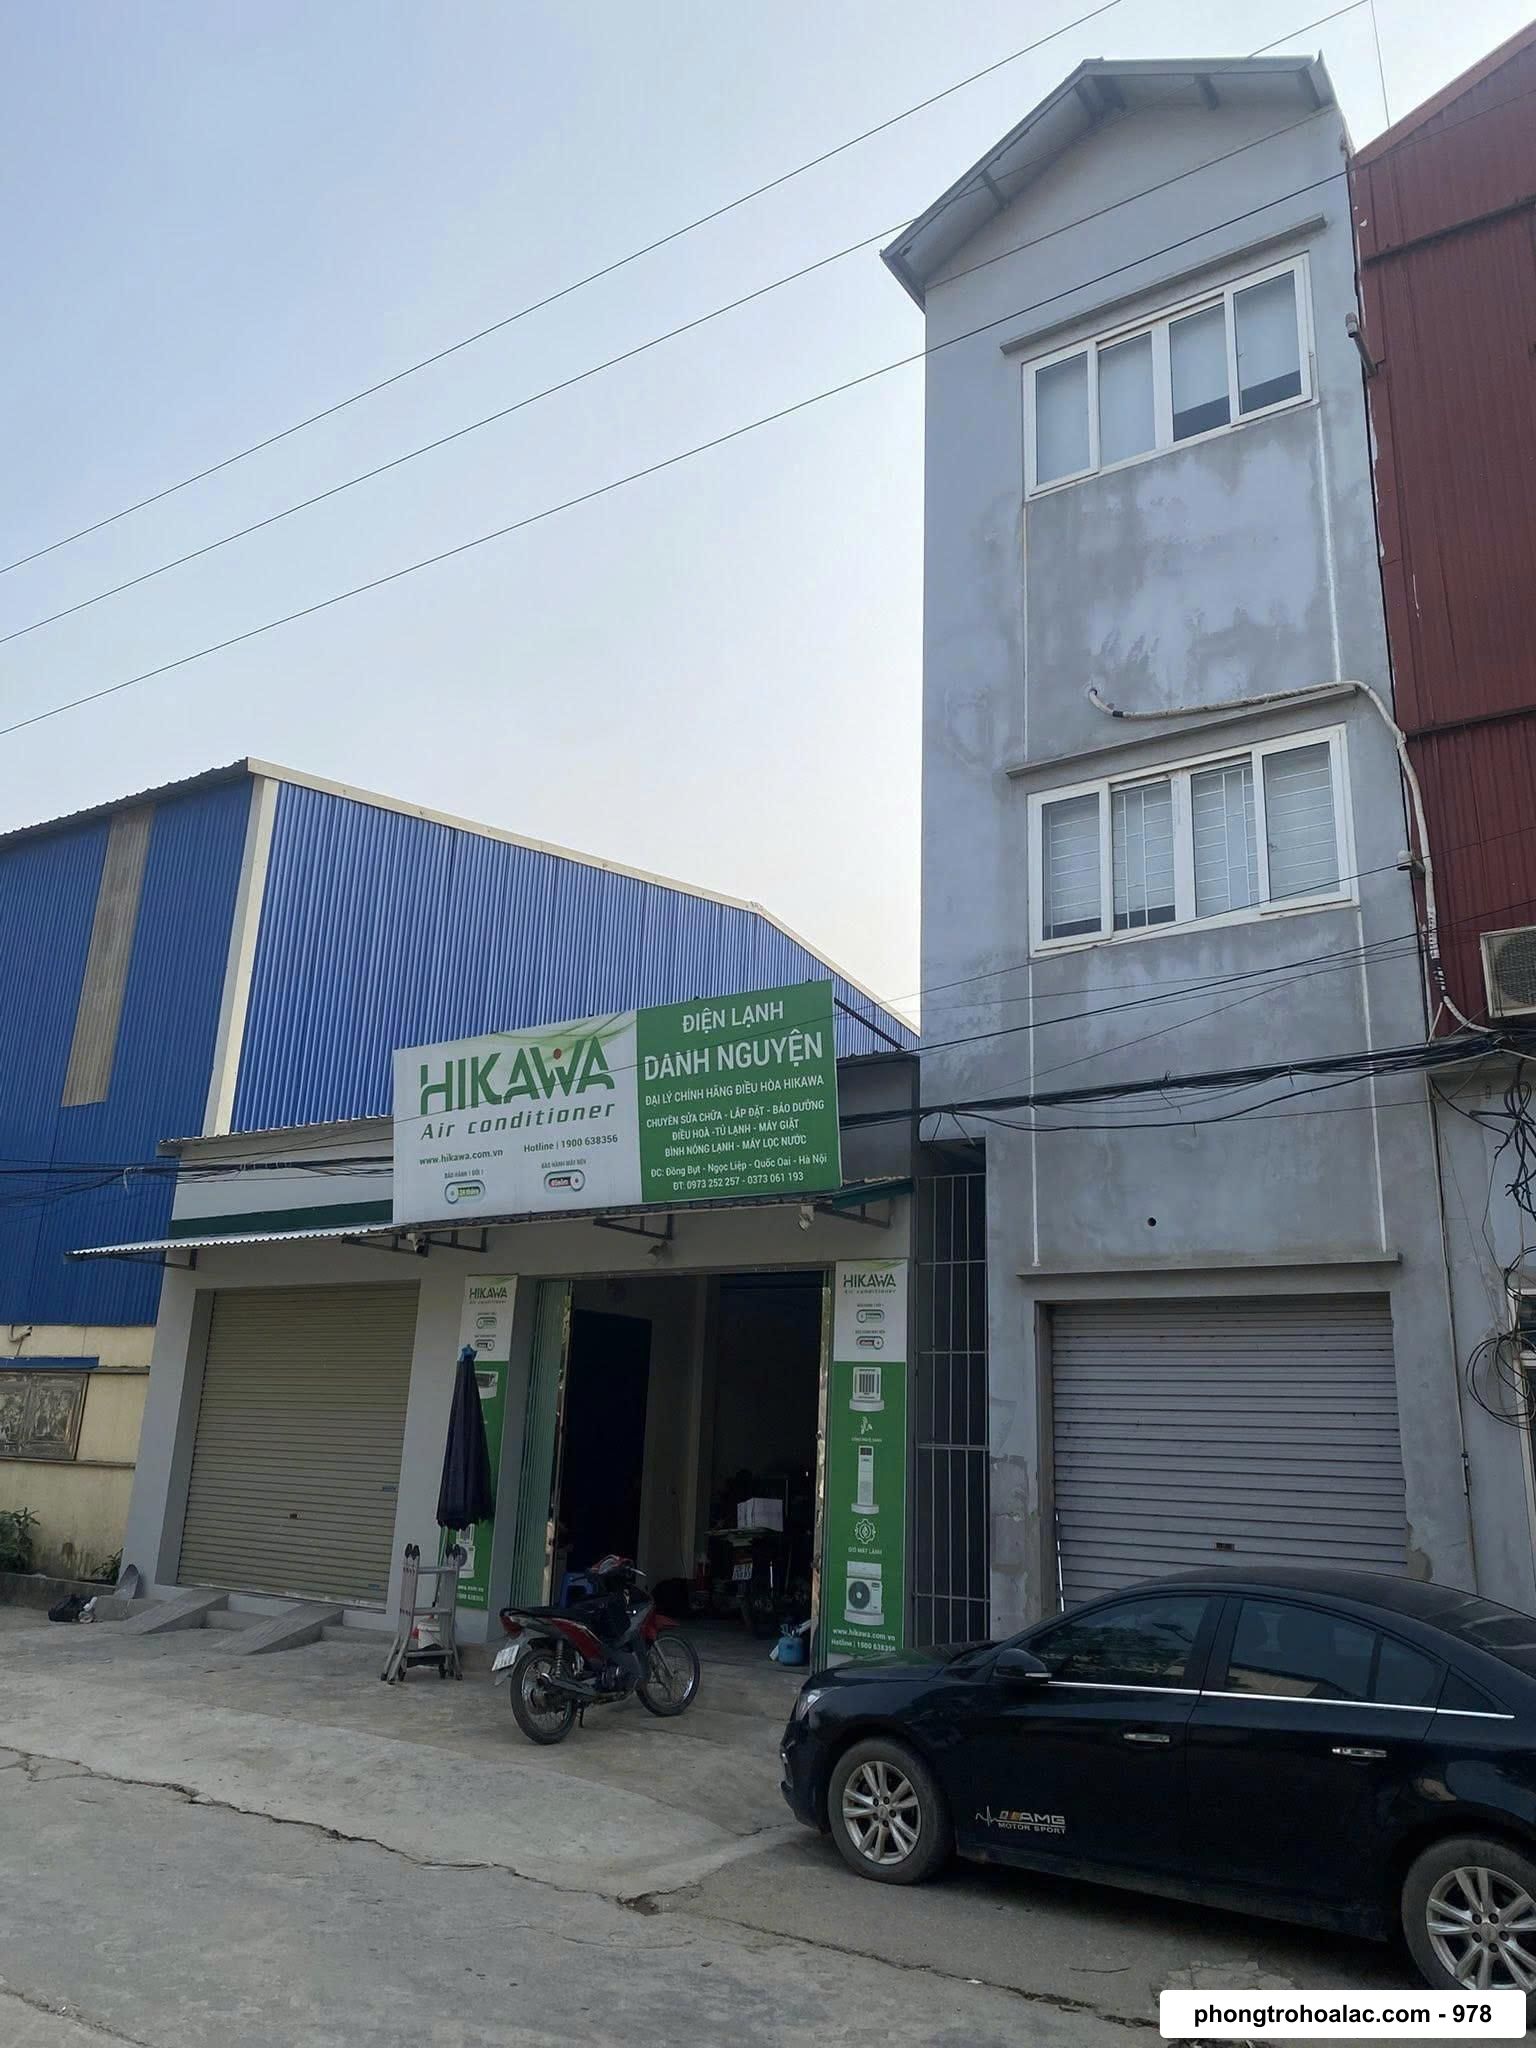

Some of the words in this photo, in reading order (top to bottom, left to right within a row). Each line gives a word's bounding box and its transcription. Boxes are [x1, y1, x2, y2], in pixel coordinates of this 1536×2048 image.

[681, 1007, 725, 1034] ĐIỆN
[731, 1000, 784, 1028] LẠNH
[644, 1048, 710, 1081] DANH
[717, 1028, 823, 1071] NGUYỆN
[420, 1036, 615, 1115] HIKAWA
[645, 1094, 660, 1107] ĐẠI
[663, 1090, 672, 1104] LÝ
[674, 1088, 704, 1102] CHÍNH
[706, 1084, 733, 1098] HÃNG
[735, 1080, 758, 1095] ĐIỀU
[760, 1078, 782, 1092] HÒA
[784, 1075, 825, 1089] HIKAWA
[421, 1122, 455, 1140] Air
[467, 1103, 616, 1135] conditioner
[646, 1114, 679, 1128] CHUYÊN
[680, 1112, 698, 1124] SỬA
[699, 1109, 722, 1122] CHỮA
[772, 1101, 791, 1115] BẢO
[672, 1128, 691, 1141] ĐIỀU
[728, 1123, 751, 1137] LẠNH
[758, 1120, 778, 1132] MÁY
[524, 1141, 554, 1152] Hotline
[561, 1138, 583, 1148] 1900
[584, 1134, 618, 1146] 638356
[664, 1146, 685, 1157] BÌNH
[686, 1143, 710, 1155] NÓNG
[711, 1141, 735, 1154] LẠNH
[742, 1137, 760, 1149] MÁY
[763, 1137, 780, 1149] LỌC
[419, 1149, 503, 1165] www.hikawa.com.vn
[707, 1163, 728, 1174] Ngọc
[754, 1158, 776, 1169] Quốc
[777, 1156, 791, 1167] Oai
[798, 1154, 811, 1165] Hà
[812, 1153, 827, 1164] Nội
[686, 1179, 706, 1190] 0973
[708, 1178, 723, 1188] 252
[725, 1176, 740, 1186] 257
[747, 1174, 768, 1185] 0373
[770, 1173, 785, 1183] 061
[789, 1171, 804, 1181] 193
[843, 1273, 896, 1288] HIKAWA
[469, 1288, 507, 1299] HIKAWA
[1020, 1812, 1065, 1825] AMG
[998, 1823, 1031, 1832] MOTOR
[1034, 1826, 1065, 1835] SPORT
